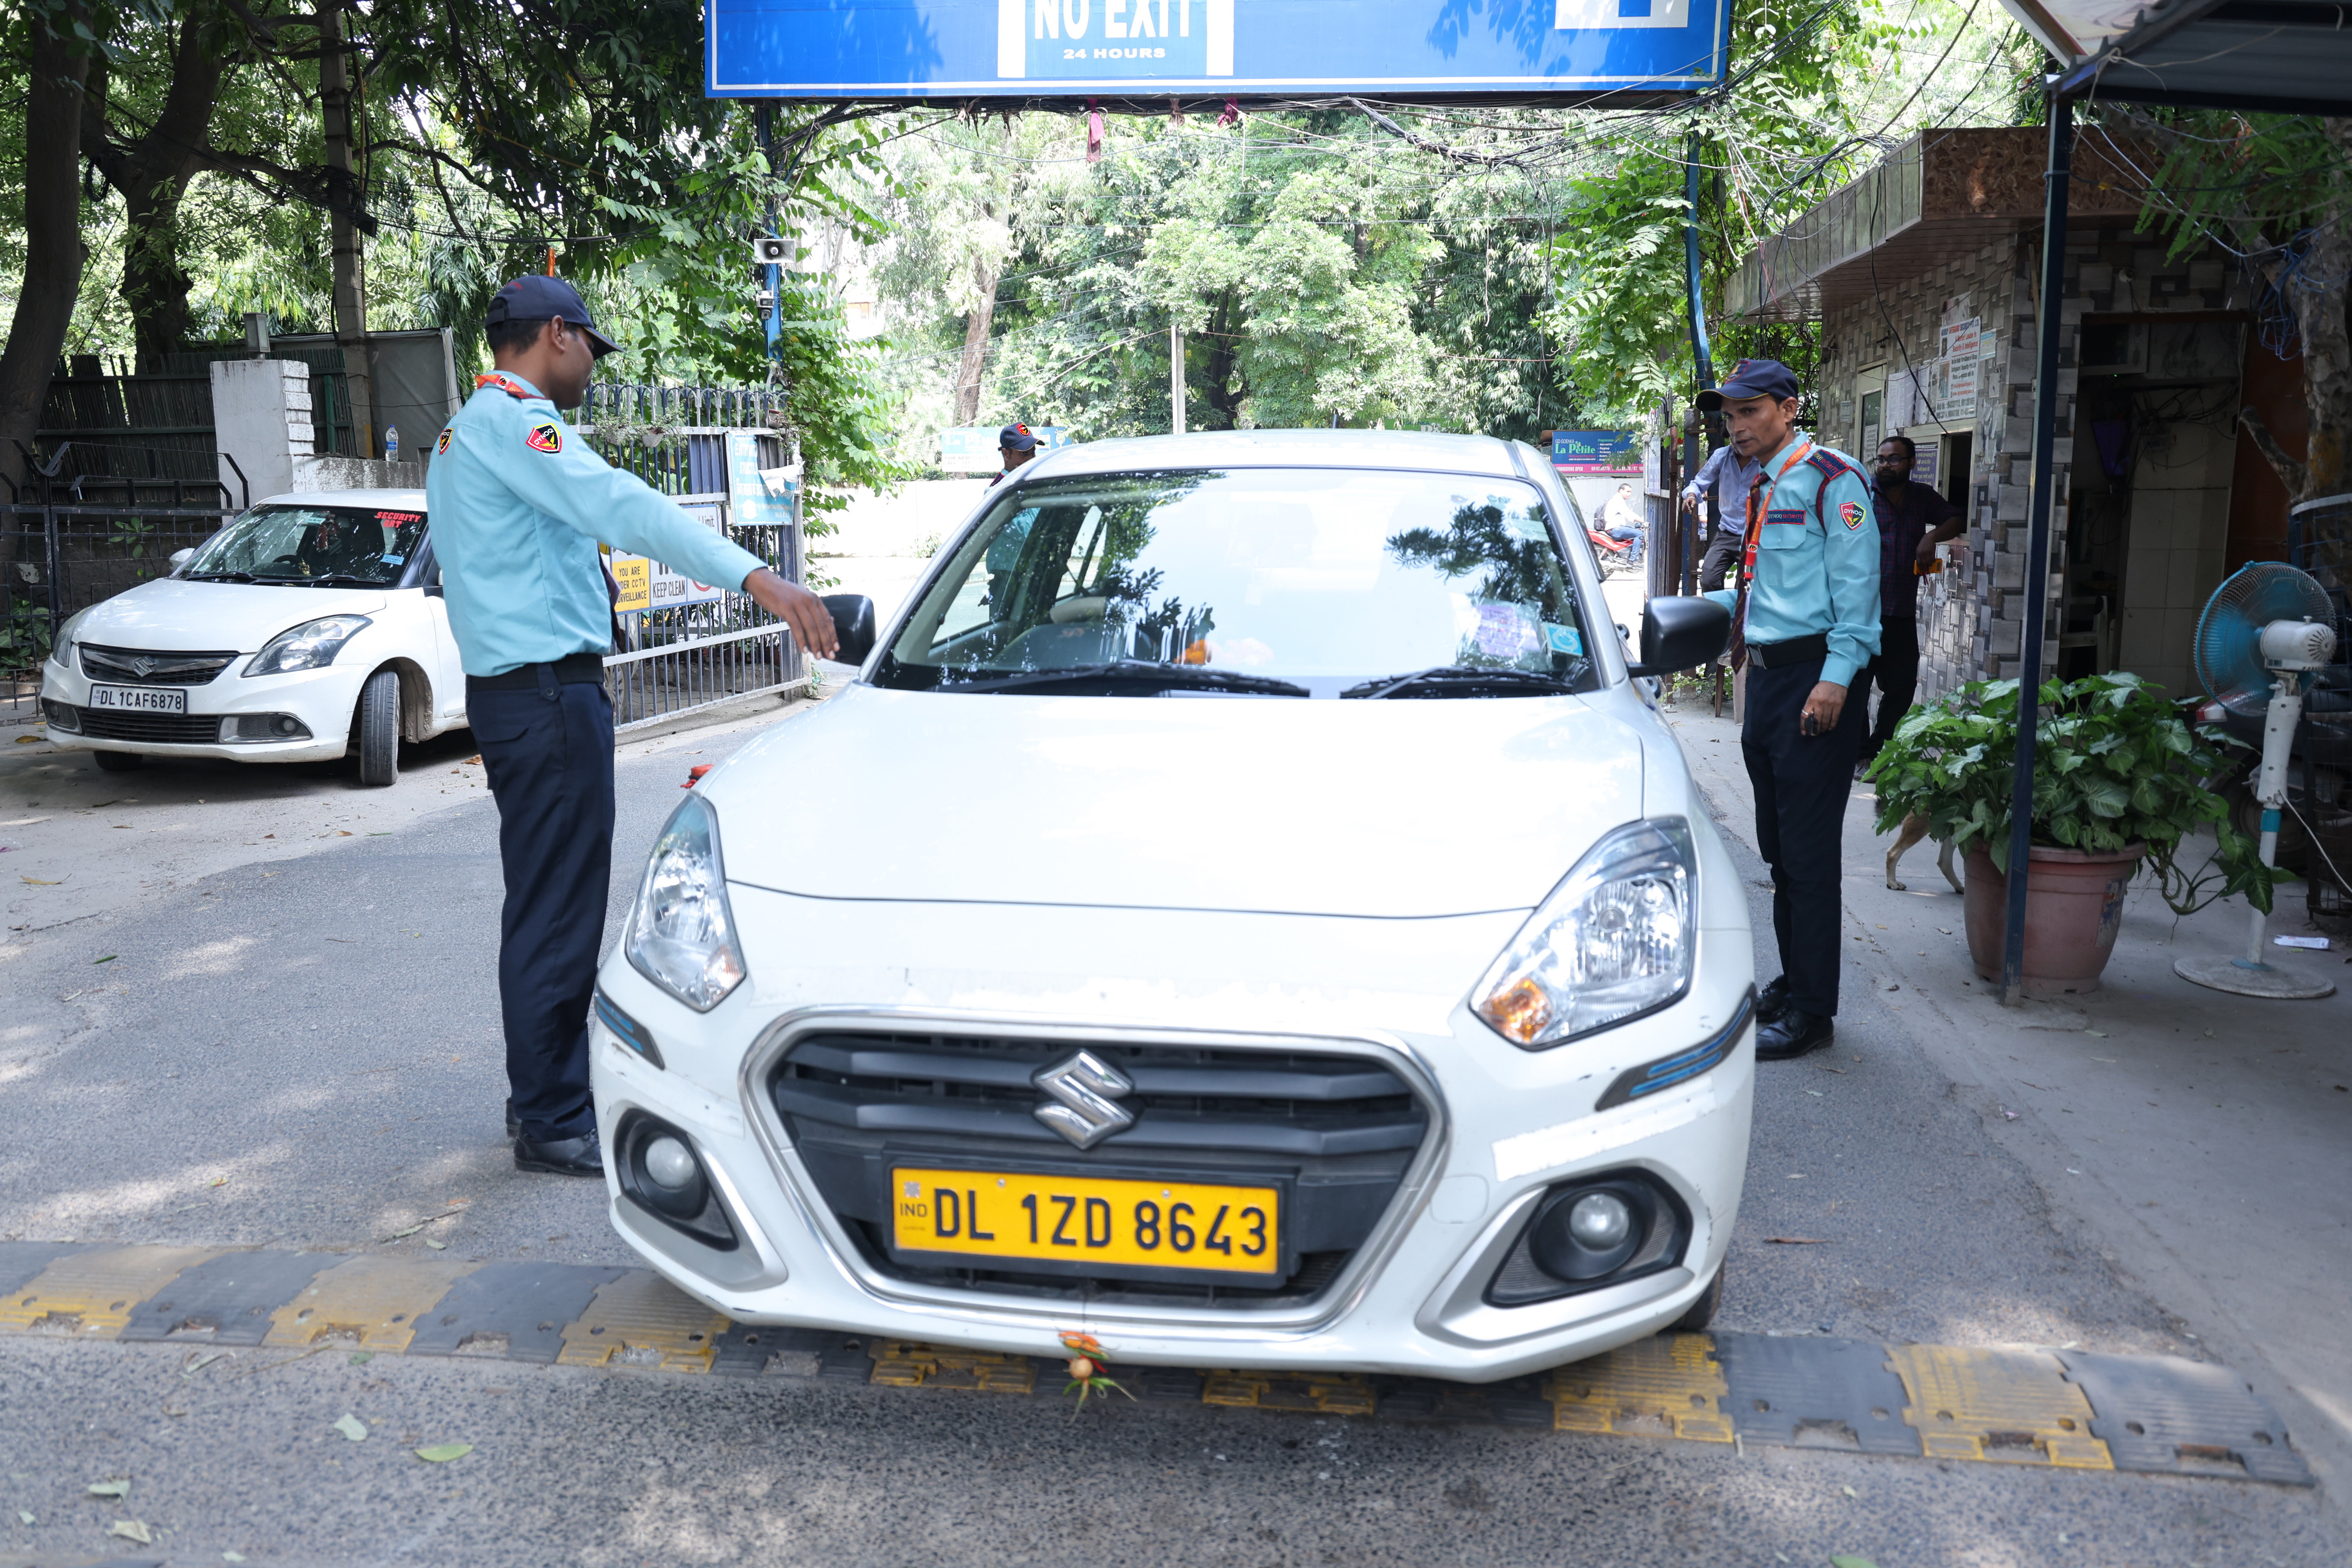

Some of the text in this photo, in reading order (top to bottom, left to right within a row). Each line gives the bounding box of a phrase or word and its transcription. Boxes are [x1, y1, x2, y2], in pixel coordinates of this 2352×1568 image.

[1035, 0, 1189, 39] NO EXIT
[1063, 48, 1165, 59] 24 HOURS
[534, 428, 554, 445] DYNOQ
[1555, 443, 1596, 454] La Petite
[1820, 458, 1840, 474] SECURITY
[376, 512, 422, 522] SECURITY
[1844, 508, 1862, 517] DYNOQ
[619, 566, 640, 577] YOU ARE
[617, 578, 645, 590] NDER CCTV
[653, 580, 685, 598] KEEP CLEAN
[616, 590, 647, 603] URVEILLANCE
[100, 690, 182, 710] DL 1CAF6878
[900, 1203, 927, 1217] IND
[935, 1188, 1267, 1256] DL 1ZD 8643
